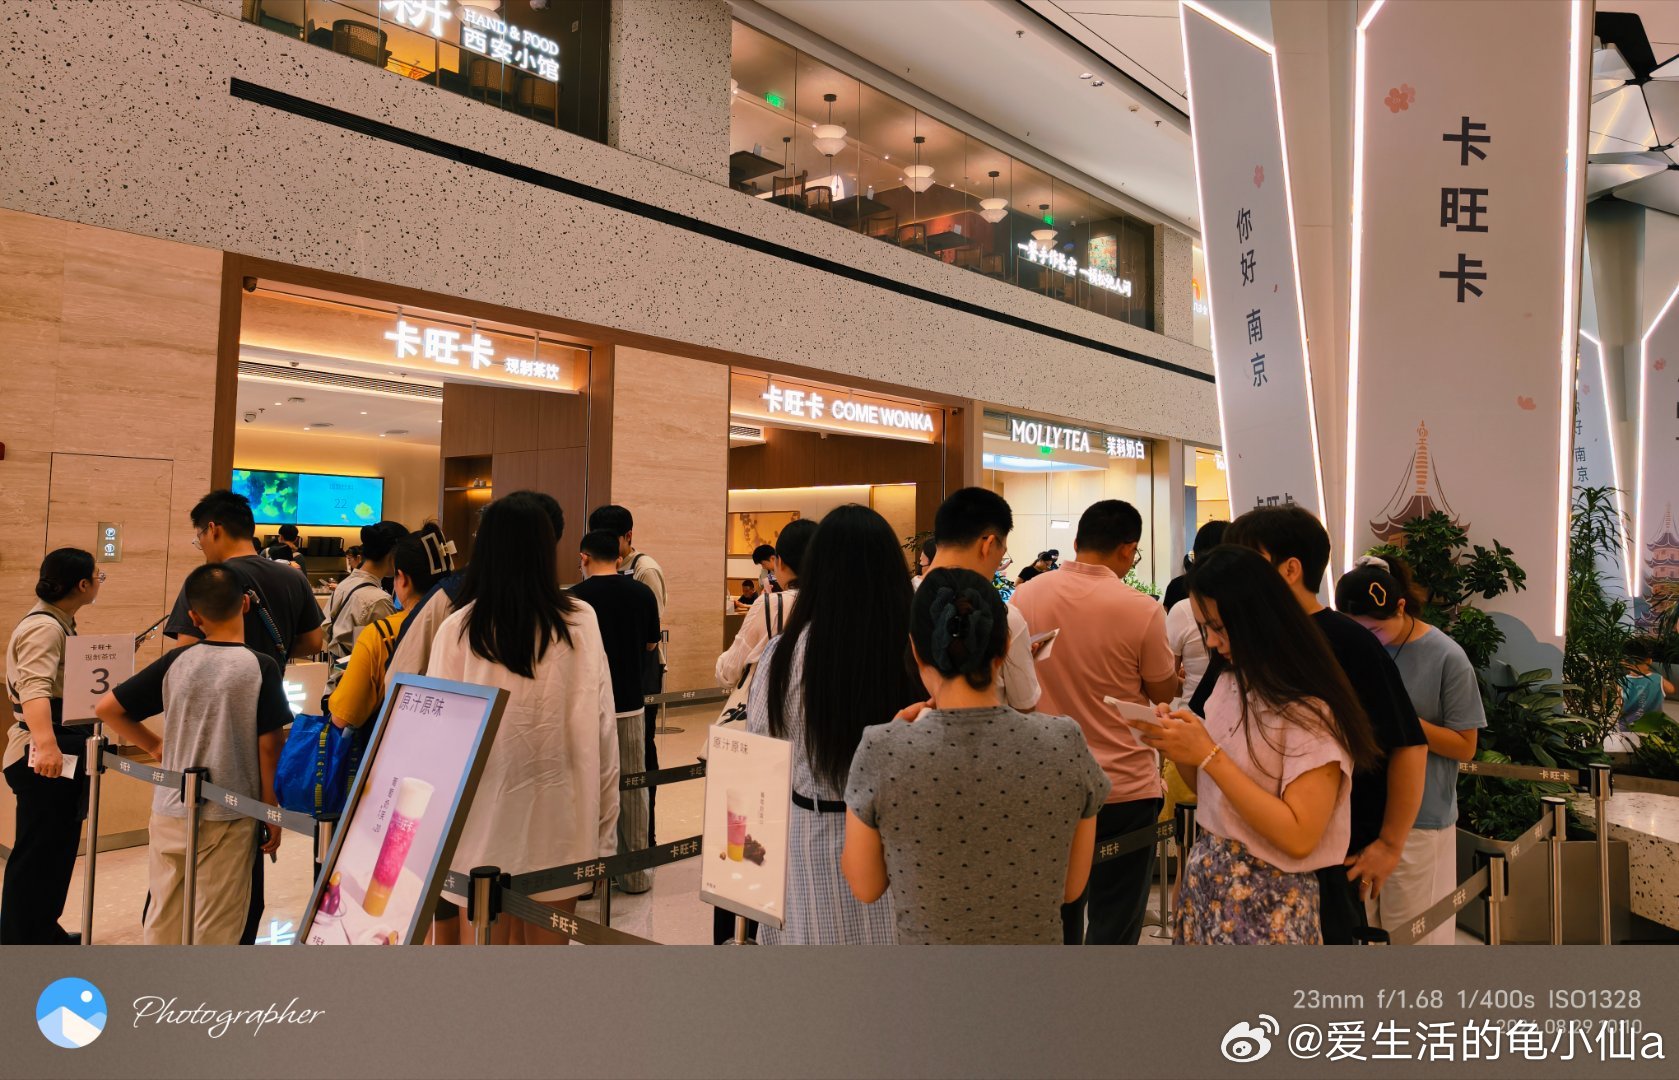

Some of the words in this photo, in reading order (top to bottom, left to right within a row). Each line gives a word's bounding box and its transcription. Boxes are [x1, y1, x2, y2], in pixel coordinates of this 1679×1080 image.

[464, 8, 506, 35] HAND
[510, 26, 521, 42] &
[523, 31, 559, 55] FOOD
[463, 27, 559, 81] 西安小馆
[1439, 116, 1491, 302] 卡旺卡
[1237, 207, 1257, 287] 你好
[384, 320, 495, 369] 卡旺卡
[1246, 308, 1268, 387] 南京
[762, 384, 825, 419] 卡旺卡
[832, 400, 878, 424] COME
[880, 407, 934, 432] WONKA
[1011, 419, 1061, 448] MOLLY
[1063, 428, 1090, 453] TEA
[1106, 436, 1145, 459] 茉莉奶白
[90, 668, 110, 694] 3
[399, 691, 445, 718] 原汁原味
[712, 736, 749, 755] 原汁原味
[625, 775, 646, 787] 卡旺卡
[1539, 770, 1571, 781] 卡旺卡
[573, 863, 606, 880] 卡旺卡
[670, 841, 698, 857] 卡旺卡
[1100, 842, 1120, 858] 卡旺卡
[1156, 824, 1174, 838] 卡旺卡
[550, 912, 579, 936] 卡旺卡
